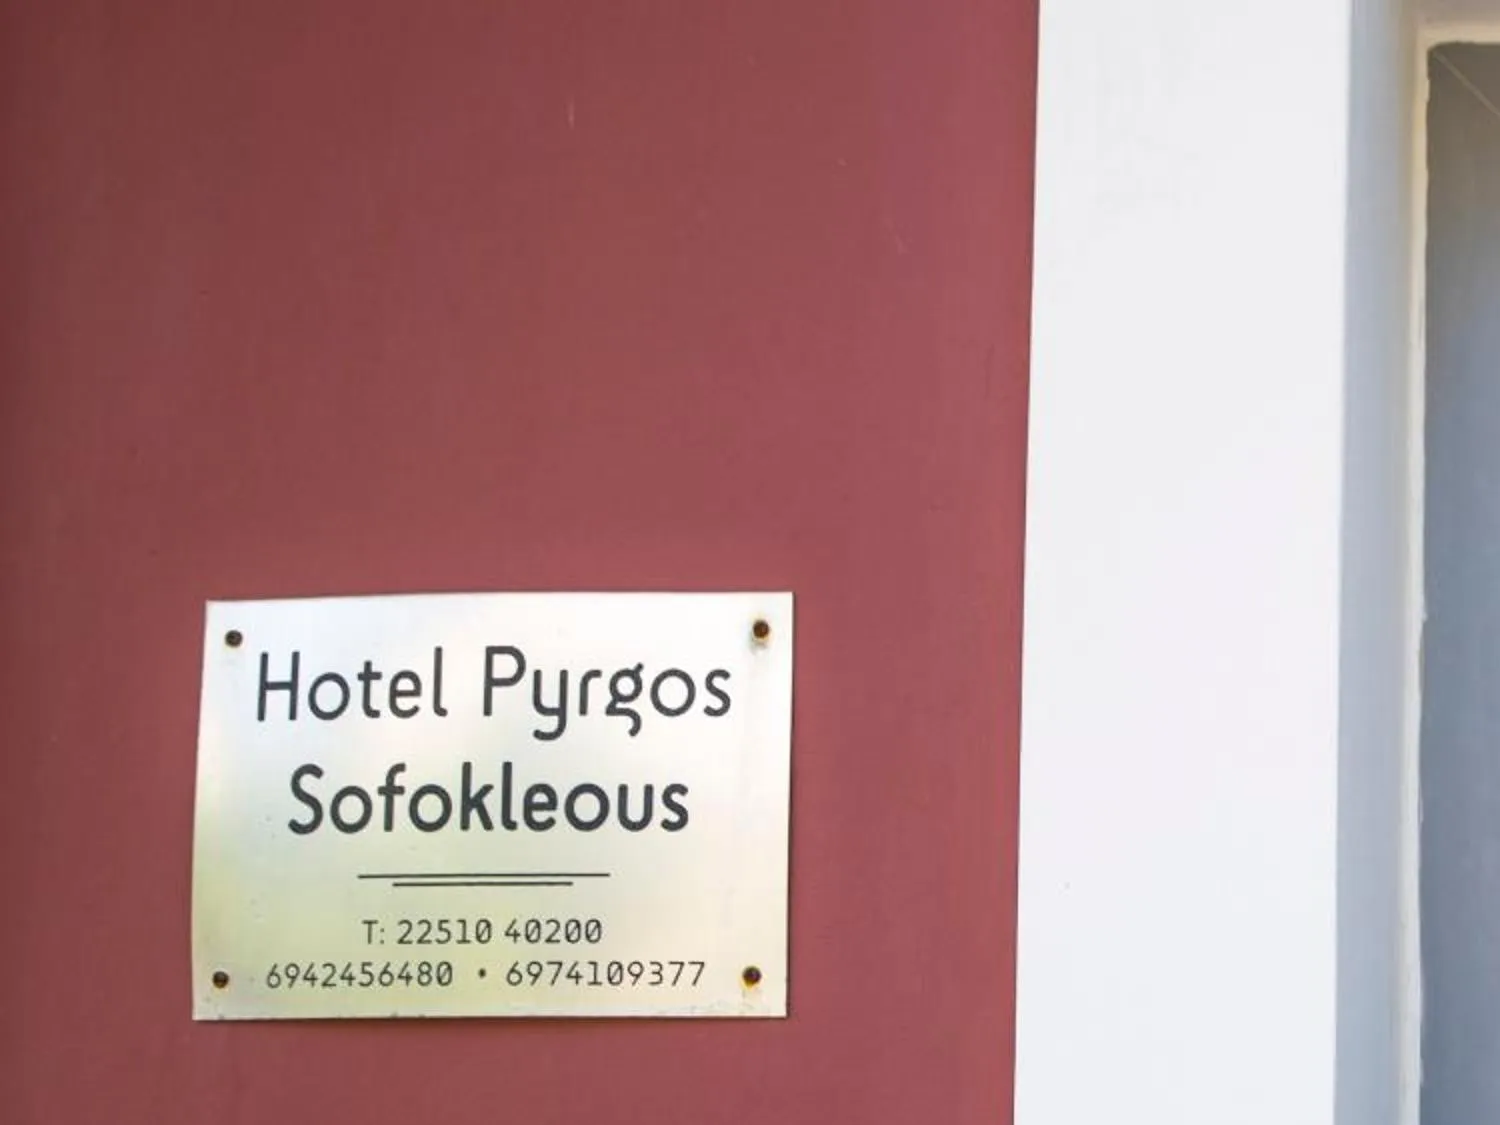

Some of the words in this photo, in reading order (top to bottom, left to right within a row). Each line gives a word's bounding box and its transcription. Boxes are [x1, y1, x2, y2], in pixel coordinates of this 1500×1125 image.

[257, 647, 448, 722] Hotel
[482, 645, 732, 741] Pyrgos
[288, 761, 690, 835] Sofokleous
[361, 919, 385, 945] T:
[396, 918, 493, 945] 22510
[503, 917, 603, 945] 40200
[266, 960, 454, 989] 6942456480
[505, 960, 706, 987] 6974109377
